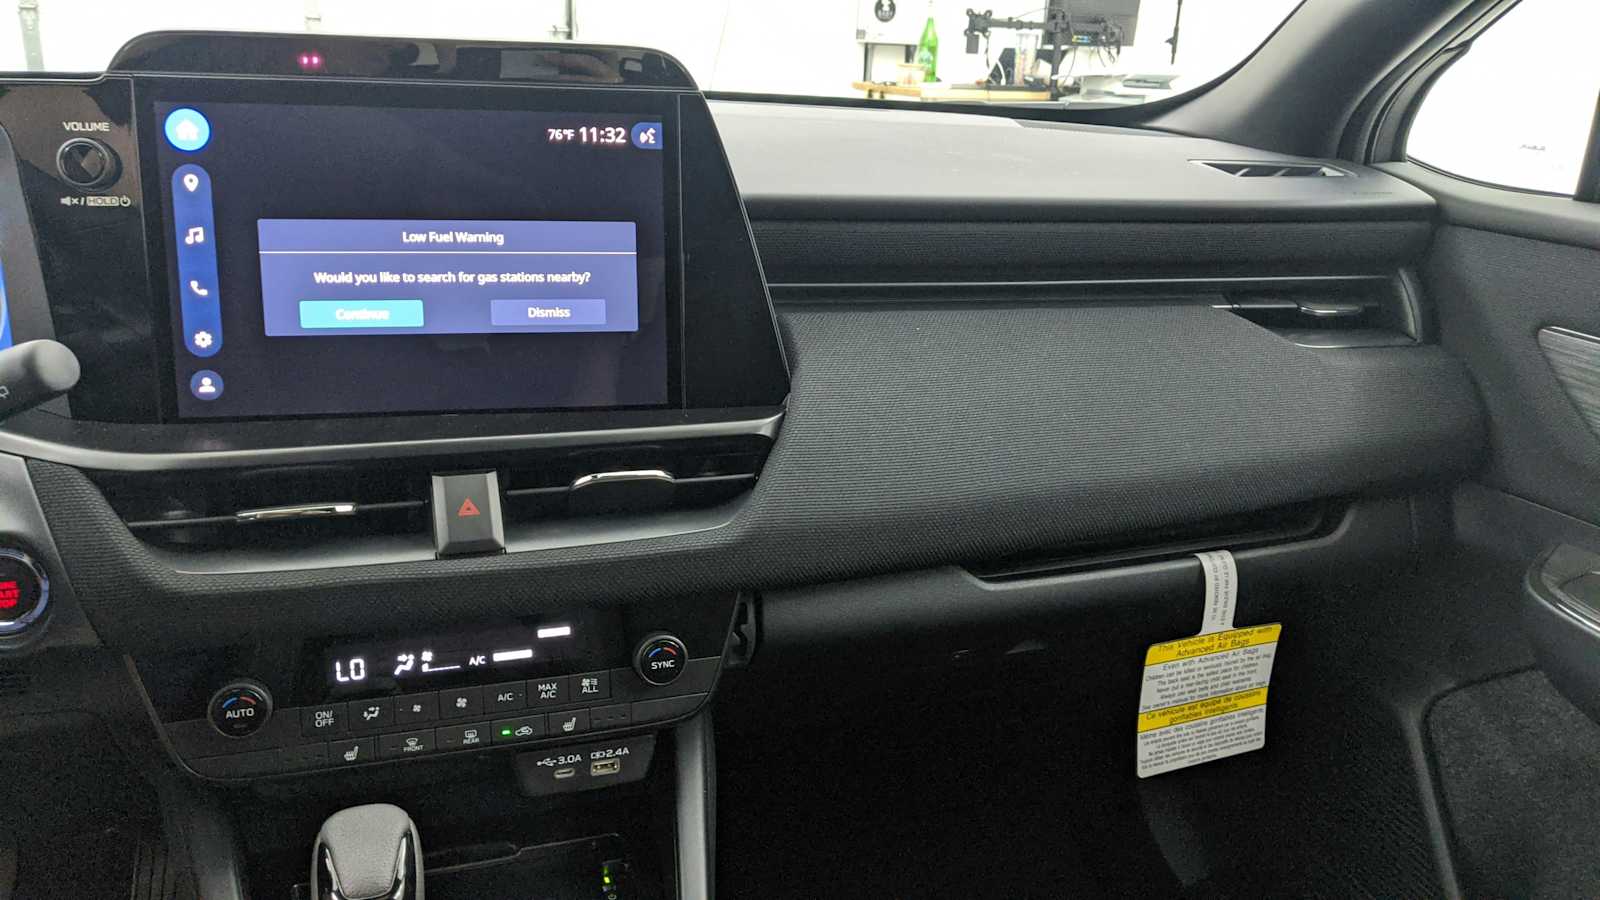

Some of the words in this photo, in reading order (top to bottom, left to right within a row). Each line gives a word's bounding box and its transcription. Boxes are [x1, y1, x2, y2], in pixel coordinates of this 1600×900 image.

[63, 121, 110, 131] VOLUME
[579, 126, 627, 143] 11:32
[402, 231, 427, 243] Low
[428, 231, 453, 243] Fuel
[455, 231, 504, 245] Warning
[313, 271, 353, 284] Would
[354, 274, 377, 286] you
[380, 271, 400, 283] like
[402, 273, 415, 283] to
[417, 271, 456, 283] search
[458, 271, 474, 283] for
[477, 274, 498, 285] gas
[500, 271, 544, 283] stations
[547, 271, 591, 285] nearby?
[335, 307, 390, 321] Continue
[527, 306, 571, 319] Dismiss
[1176, 643, 1215, 657] Advanced
[1230, 636, 1250, 649] Bags
[468, 655, 487, 667] A/C
[651, 660, 675, 670] SYNC
[538, 682, 557, 692] MAX
[582, 685, 599, 694] ALL
[497, 692, 514, 702] A/C
[540, 690, 557, 699] A/C
[225, 707, 255, 719] AUTO
[315, 710, 333, 719] ON/
[315, 718, 335, 728] OFF
[463, 737, 480, 745] REAR
[403, 744, 424, 753] FRONT
[605, 747, 630, 758] 2.4A
[558, 753, 582, 765] 3.0A
